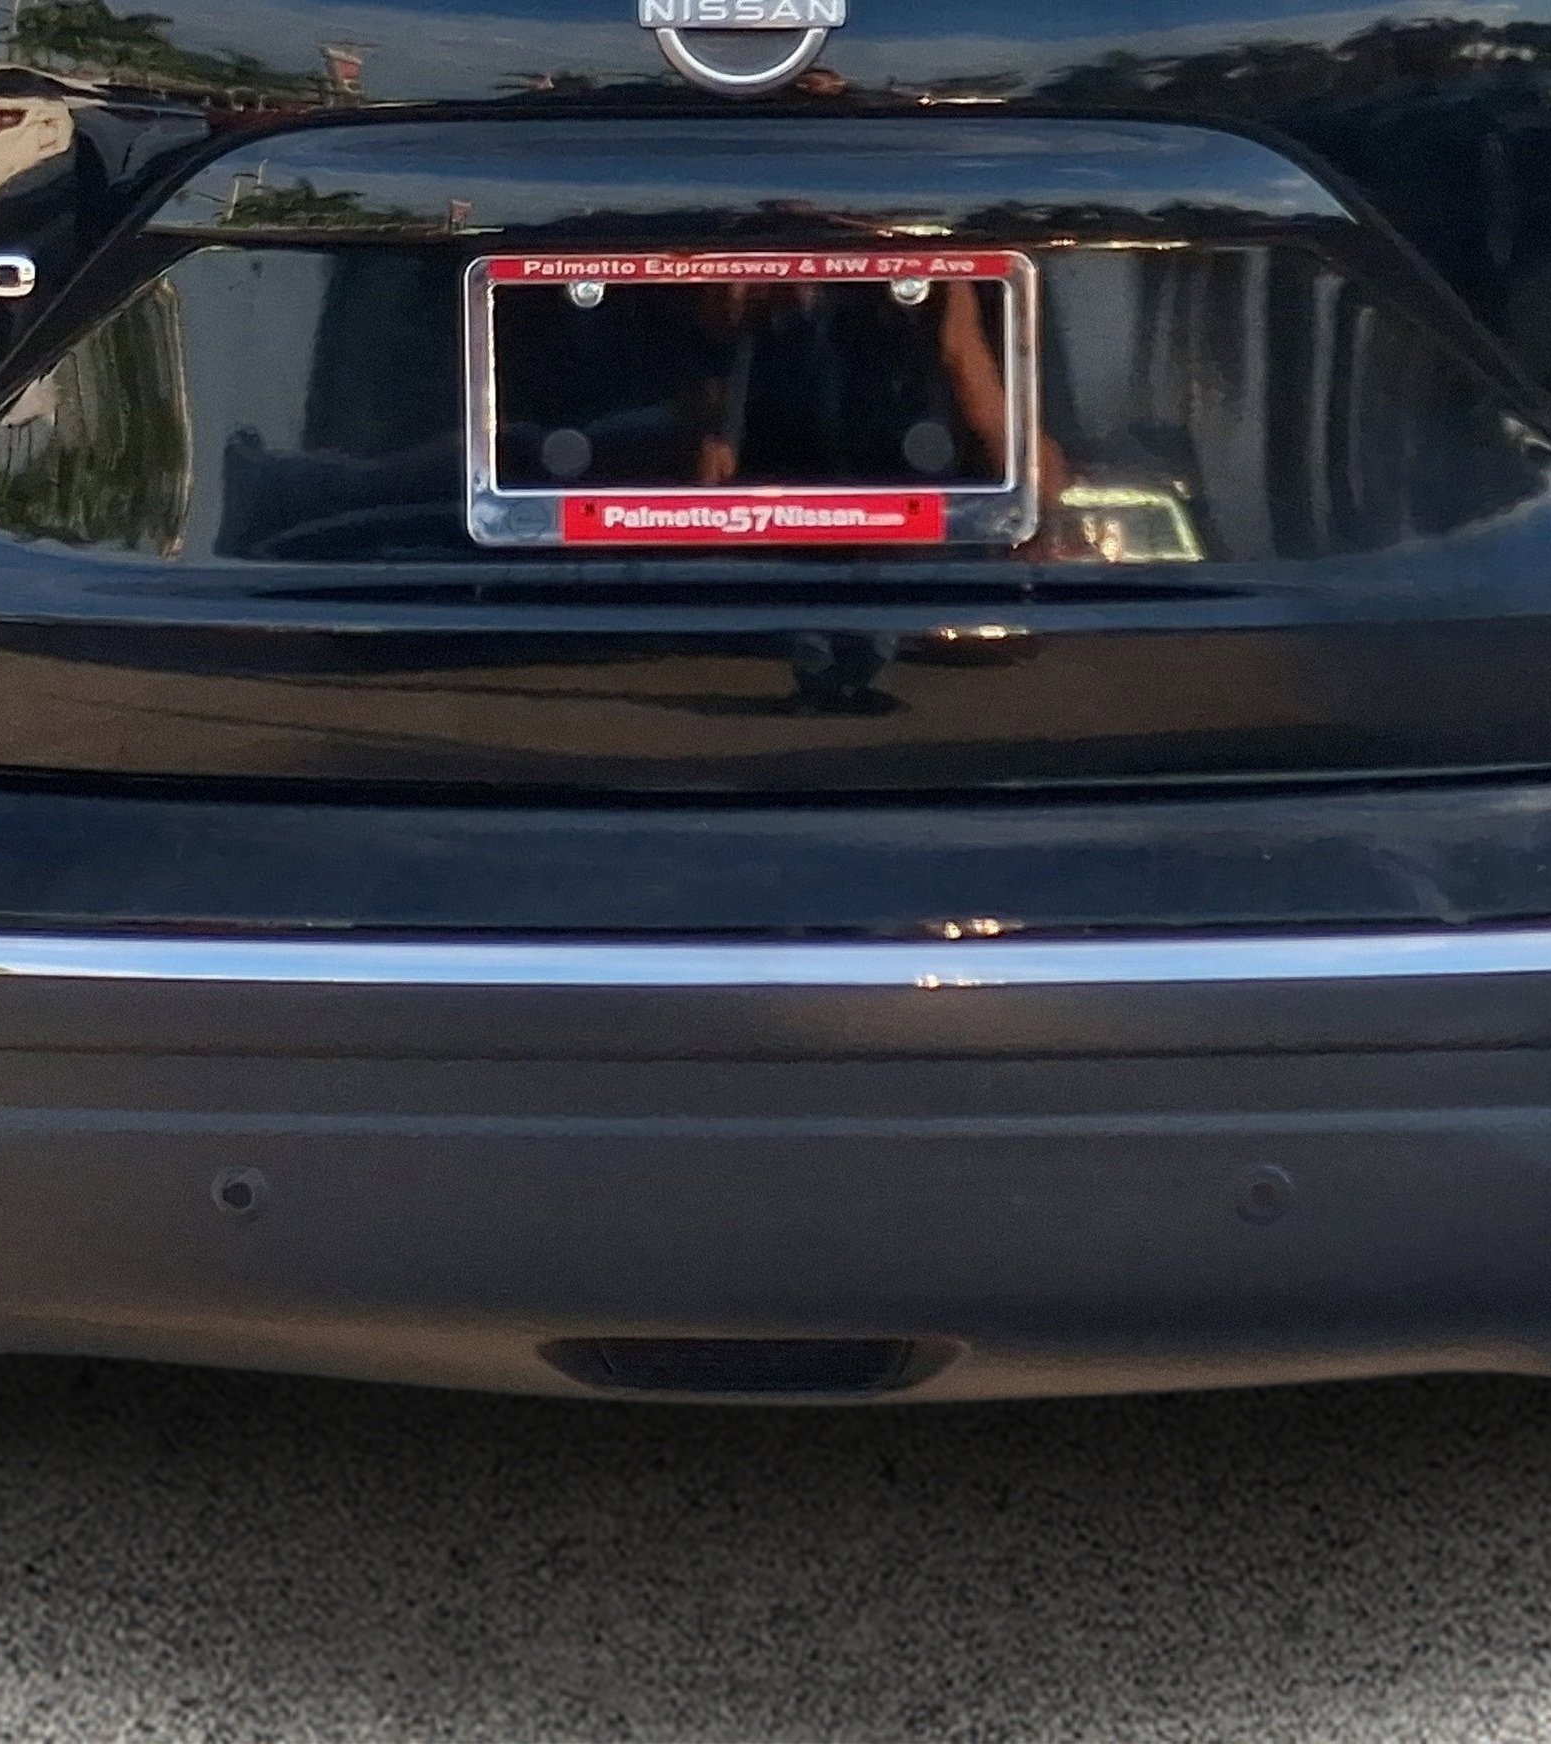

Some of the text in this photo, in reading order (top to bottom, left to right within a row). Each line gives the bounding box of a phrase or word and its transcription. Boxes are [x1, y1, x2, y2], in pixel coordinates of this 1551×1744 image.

[523, 259, 637, 276] Palmetto
[644, 258, 792, 277] Expressway
[798, 258, 817, 274] &
[825, 257, 870, 274] NW
[929, 257, 976, 274] Ave
[603, 505, 906, 534] Palmetto57Nissan
